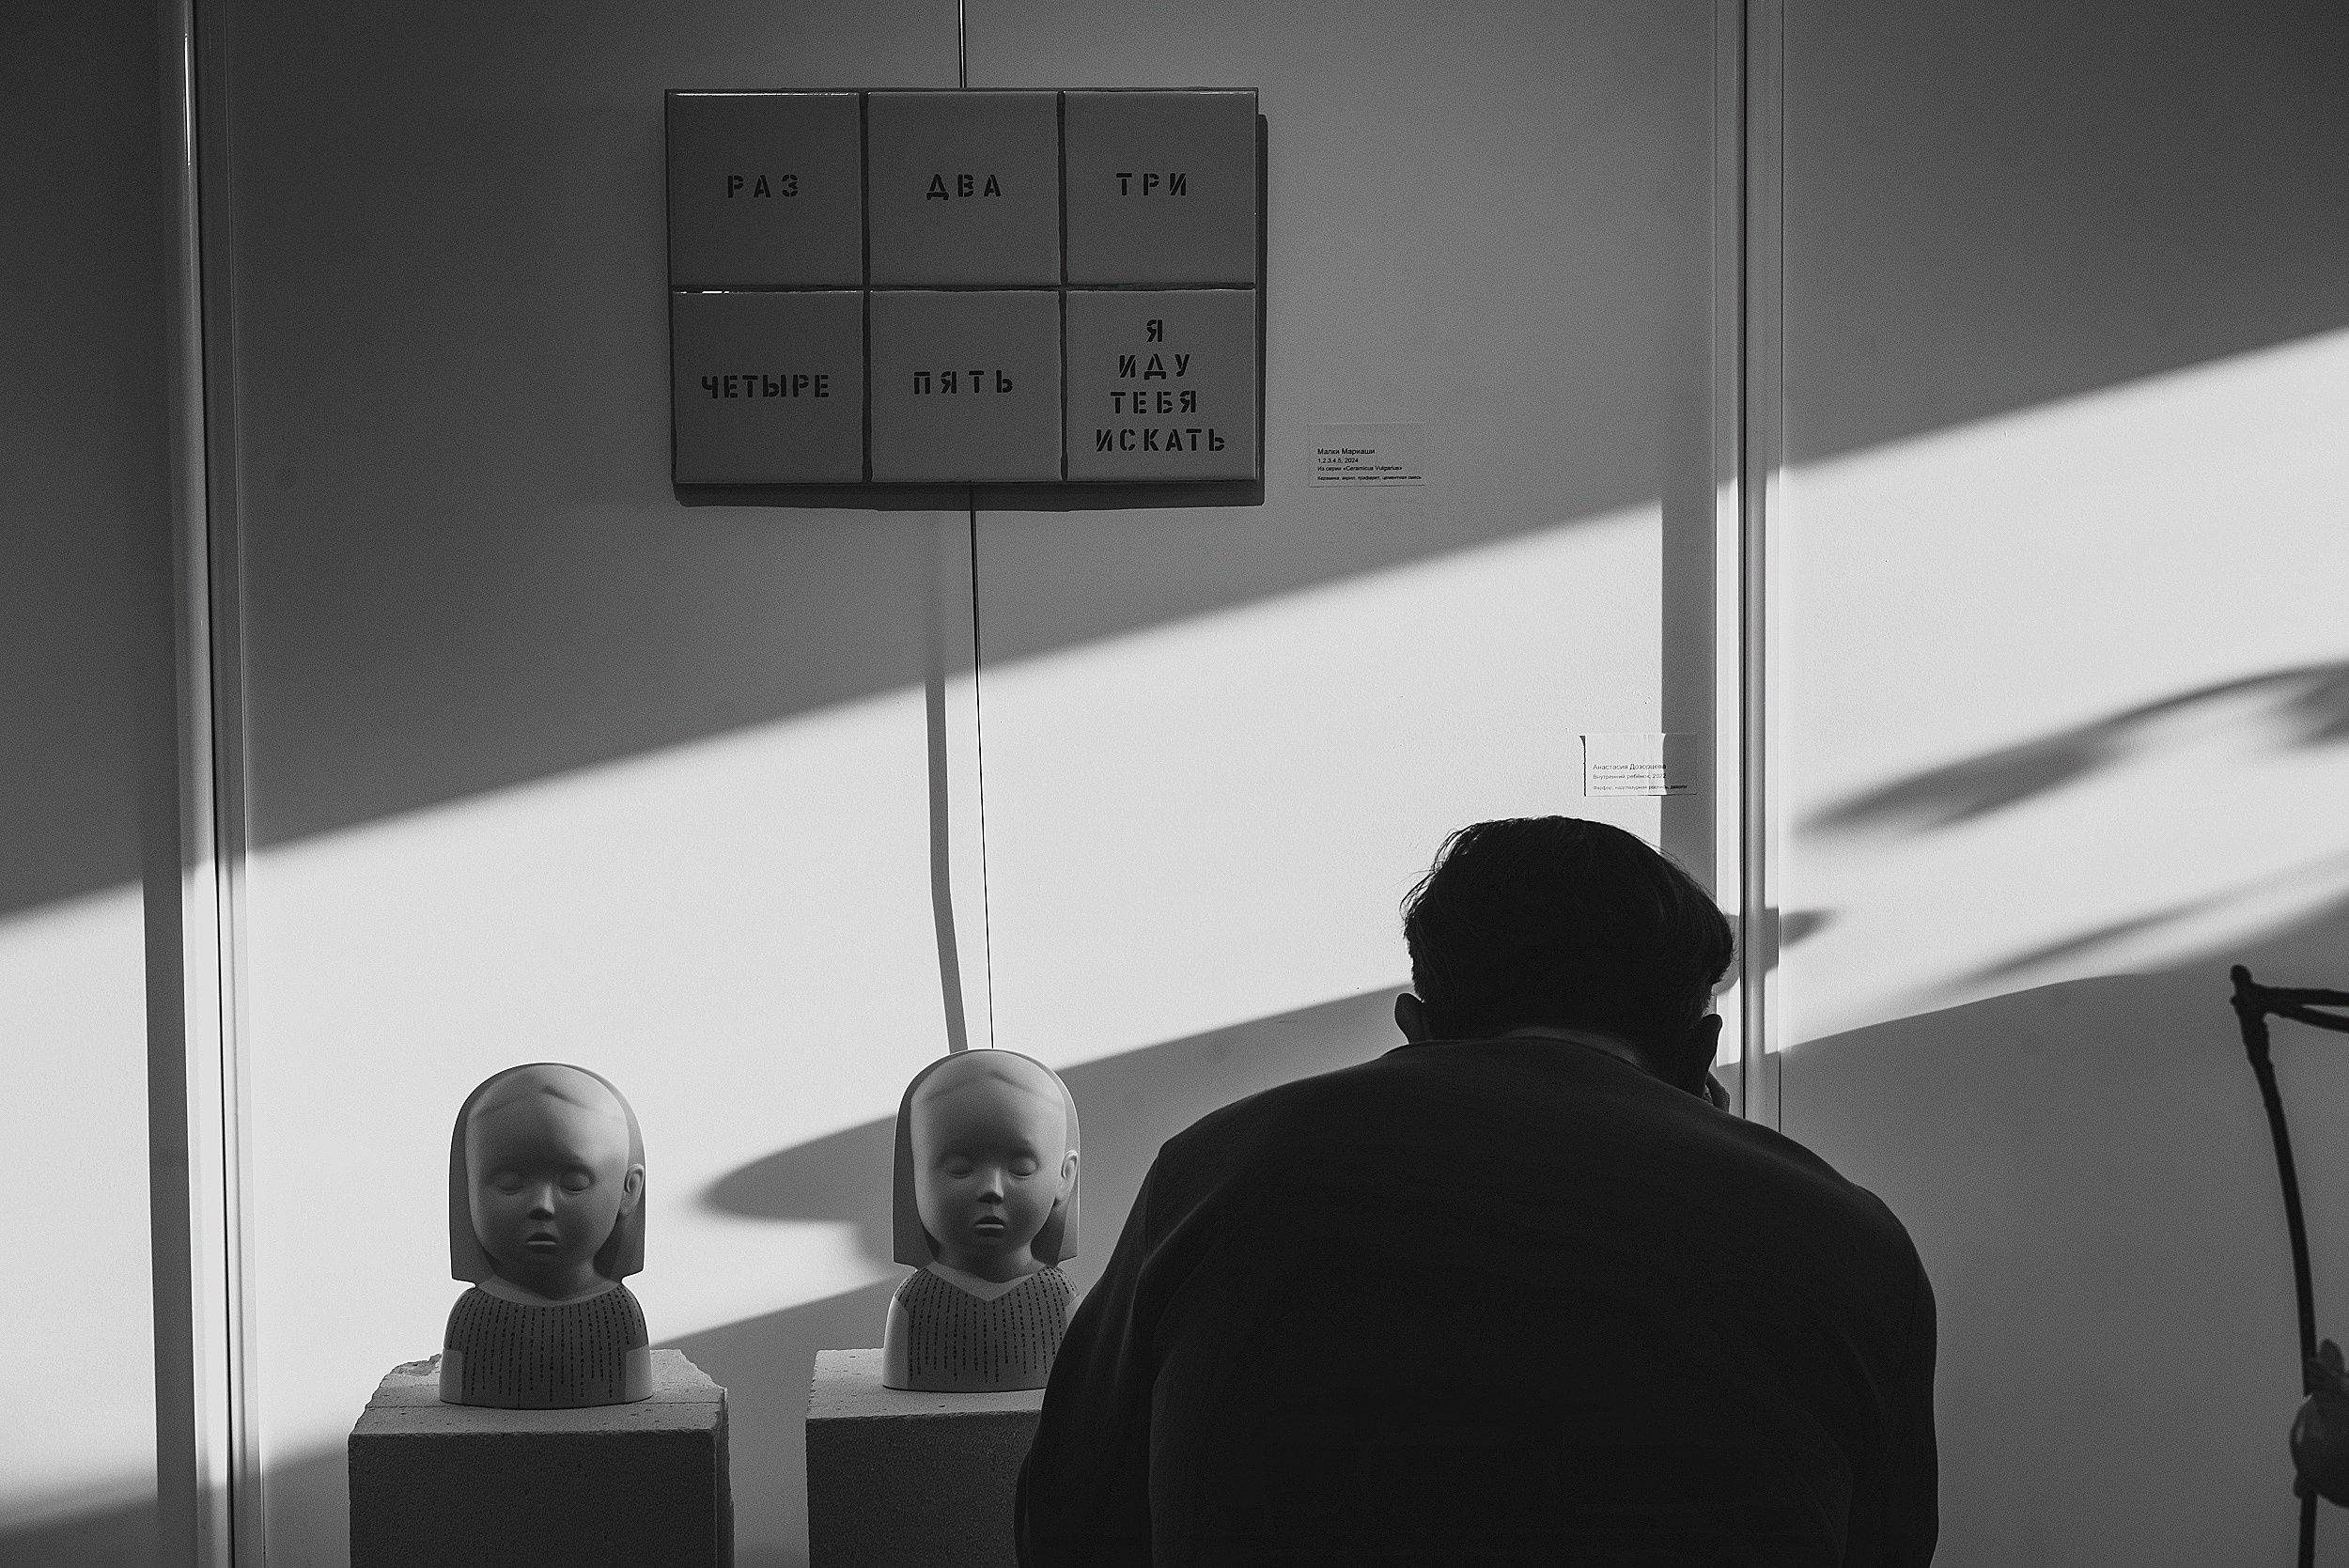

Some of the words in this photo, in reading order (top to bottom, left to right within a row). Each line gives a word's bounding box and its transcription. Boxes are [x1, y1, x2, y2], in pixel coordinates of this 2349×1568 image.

[727, 174, 799, 199] РАЗ
[926, 173, 1002, 201] ДВА
[1115, 172, 1188, 196] ТРИ
[1145, 318, 1163, 343] Я
[1118, 353, 1190, 380] ИДУ
[701, 374, 830, 399] ЧЕТЫРЕ
[913, 369, 1014, 396] ПЯТЬ
[1110, 390, 1197, 414] ТЕБЯ
[1096, 427, 1225, 453] ИСКАТЬ
